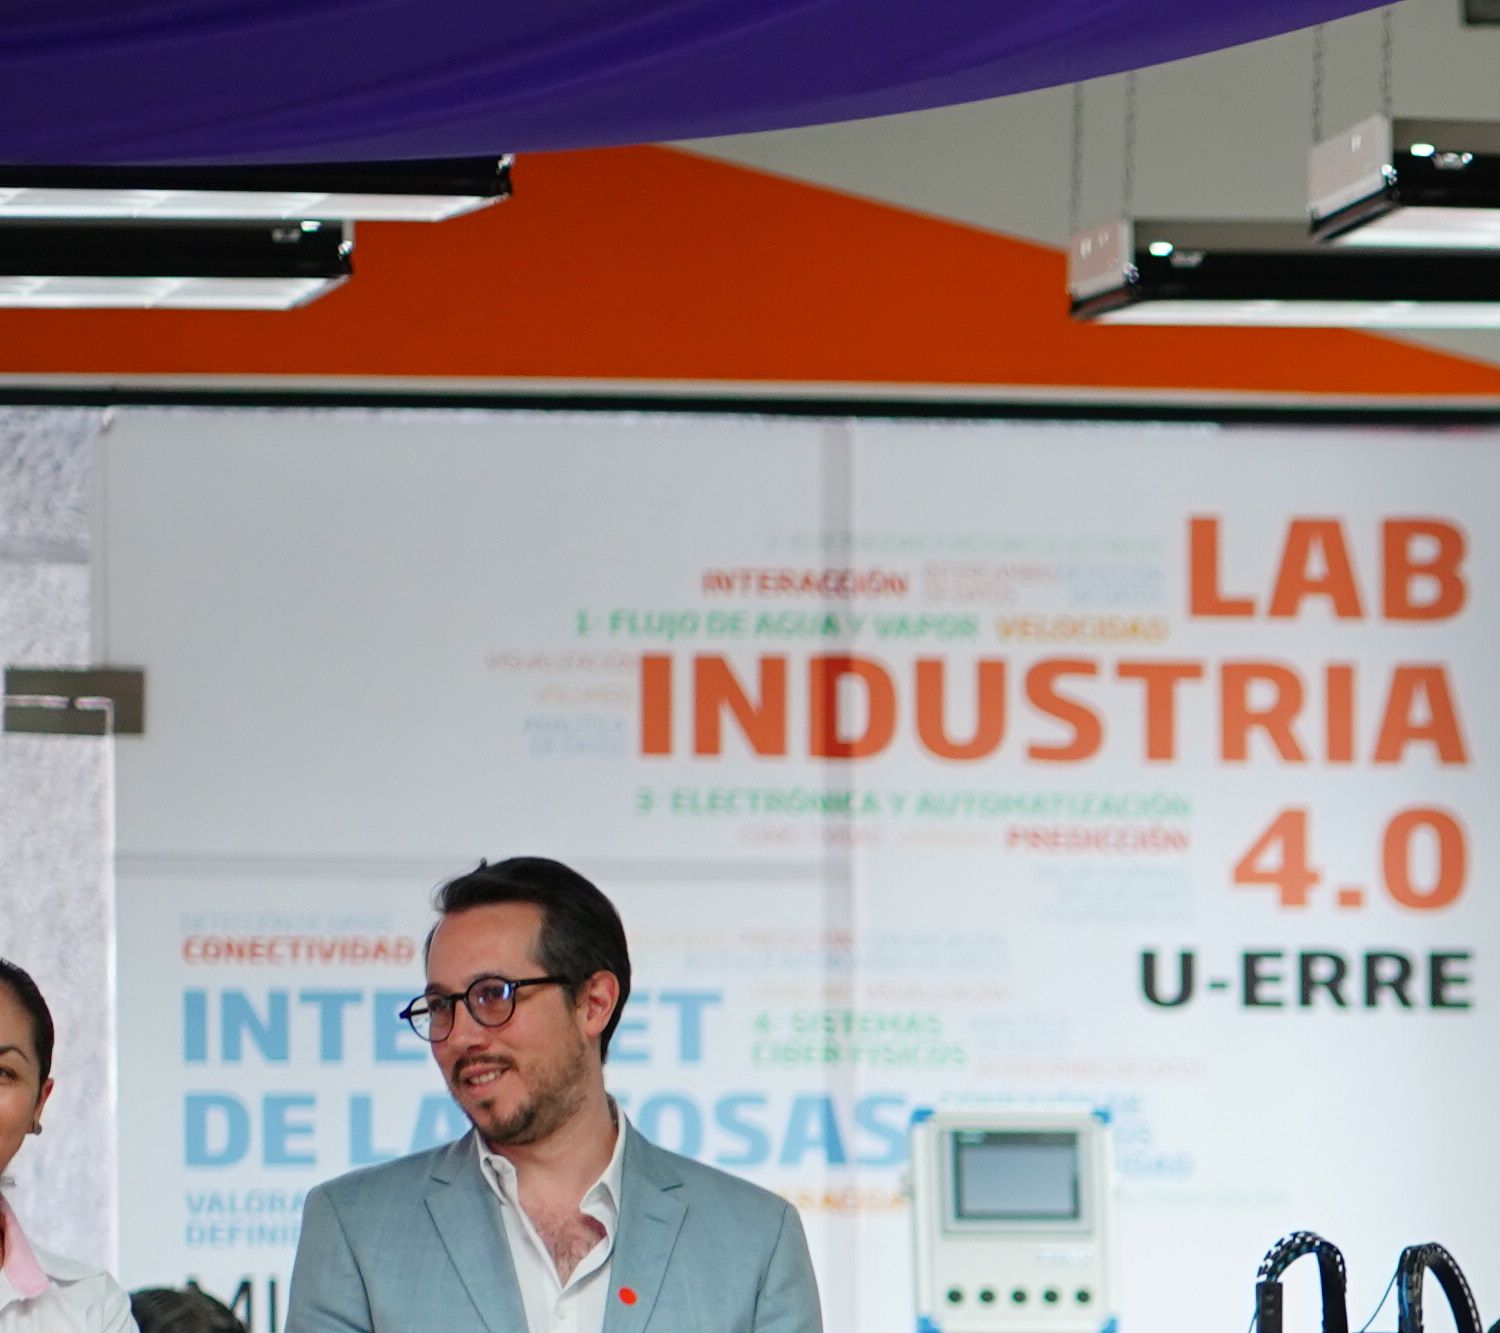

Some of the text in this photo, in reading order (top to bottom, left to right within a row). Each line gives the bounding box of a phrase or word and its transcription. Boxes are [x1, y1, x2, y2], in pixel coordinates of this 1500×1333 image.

[1186, 515, 1470, 621] LAB
[640, 653, 1470, 766] INDUSTRIA
[1232, 807, 1468, 911] 4.0
[182, 933, 414, 965] CONECTIVIDAD
[1140, 948, 1476, 1010] U-ERRE
[183, 987, 722, 1063] INTEET
[184, 1093, 318, 1168] DE
[614, 1090, 912, 1168] OSAS
